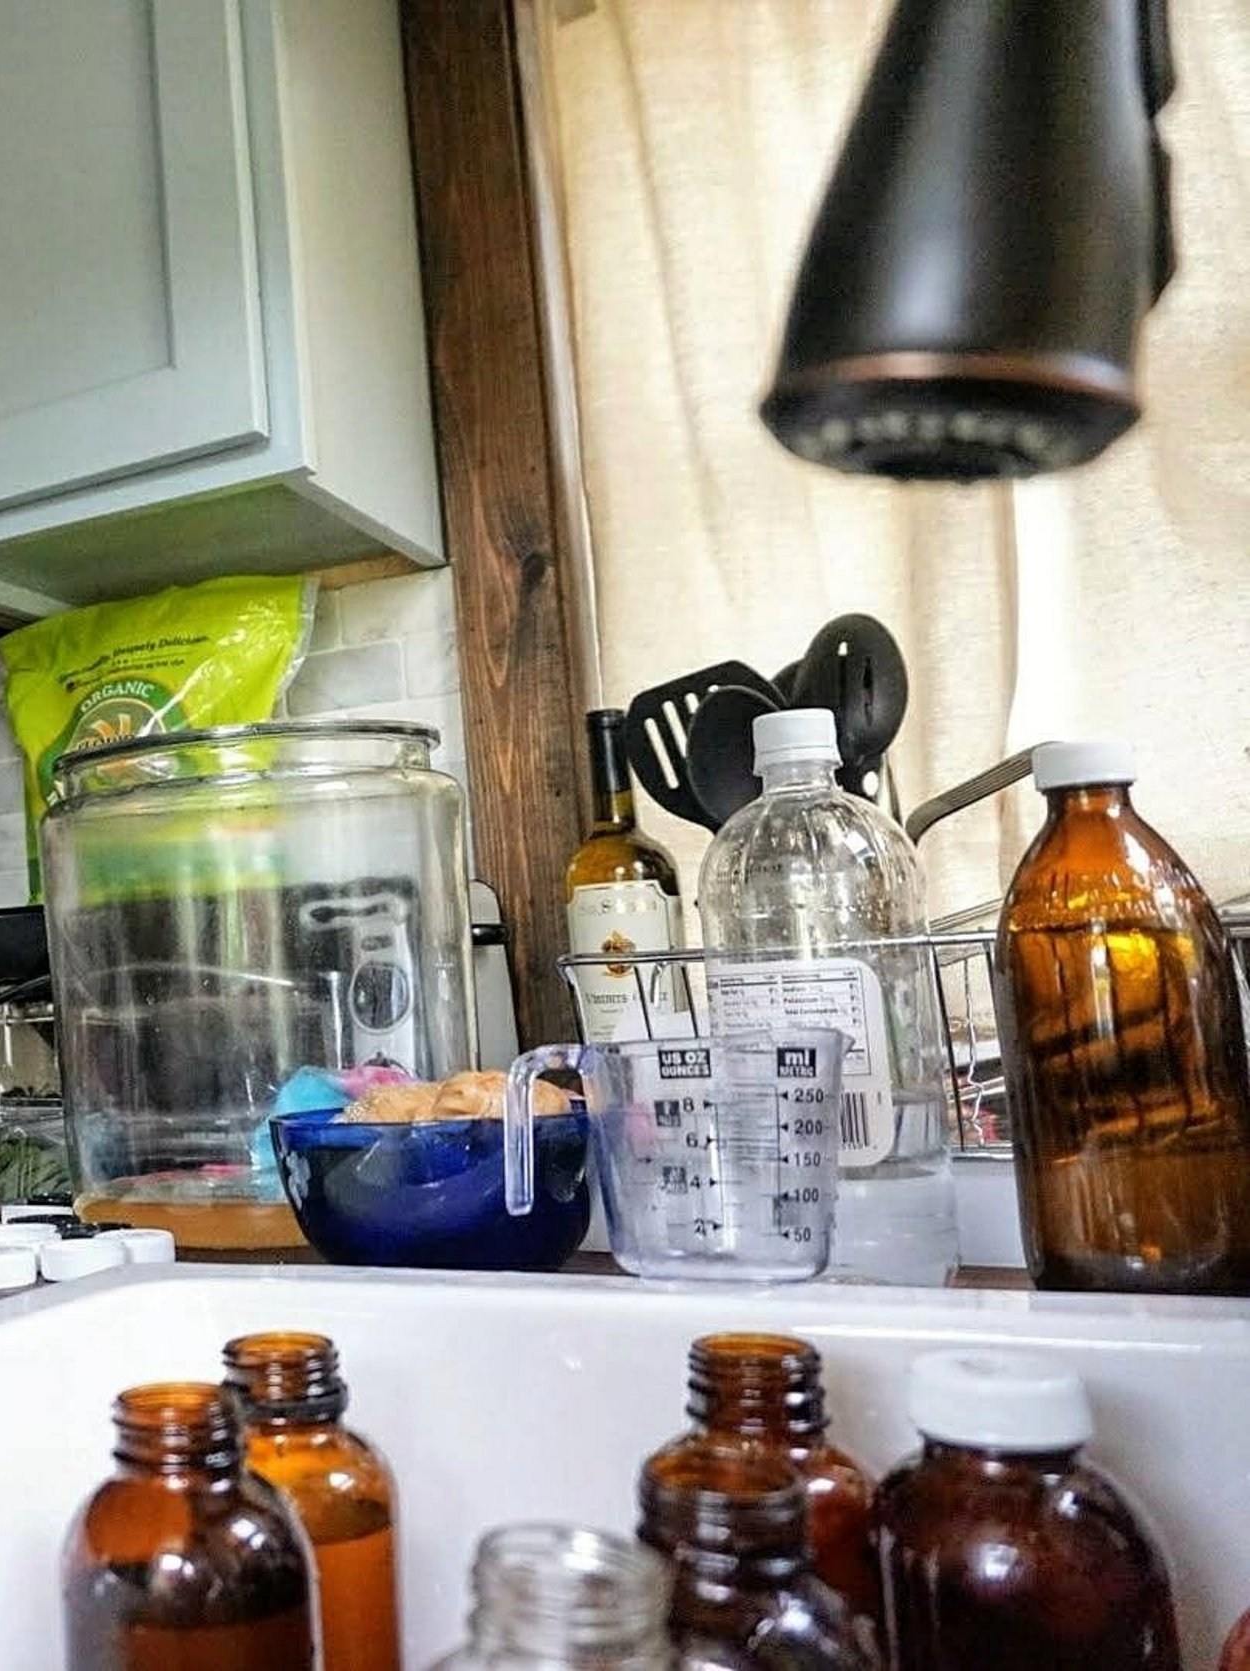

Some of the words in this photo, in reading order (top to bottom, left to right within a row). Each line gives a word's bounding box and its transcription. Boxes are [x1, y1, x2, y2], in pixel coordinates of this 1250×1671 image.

[80, 680, 155, 713] ORGANIC
[784, 1050, 809, 1066] ml
[794, 1088, 824, 1104] 250
[683, 1097, 695, 1112] 8
[794, 1119, 823, 1135] 200
[686, 1132, 698, 1148] 6
[794, 1152, 821, 1167] 150
[690, 1176, 701, 1189] 4
[794, 1187, 819, 1202] 100
[794, 1227, 811, 1242] 50
